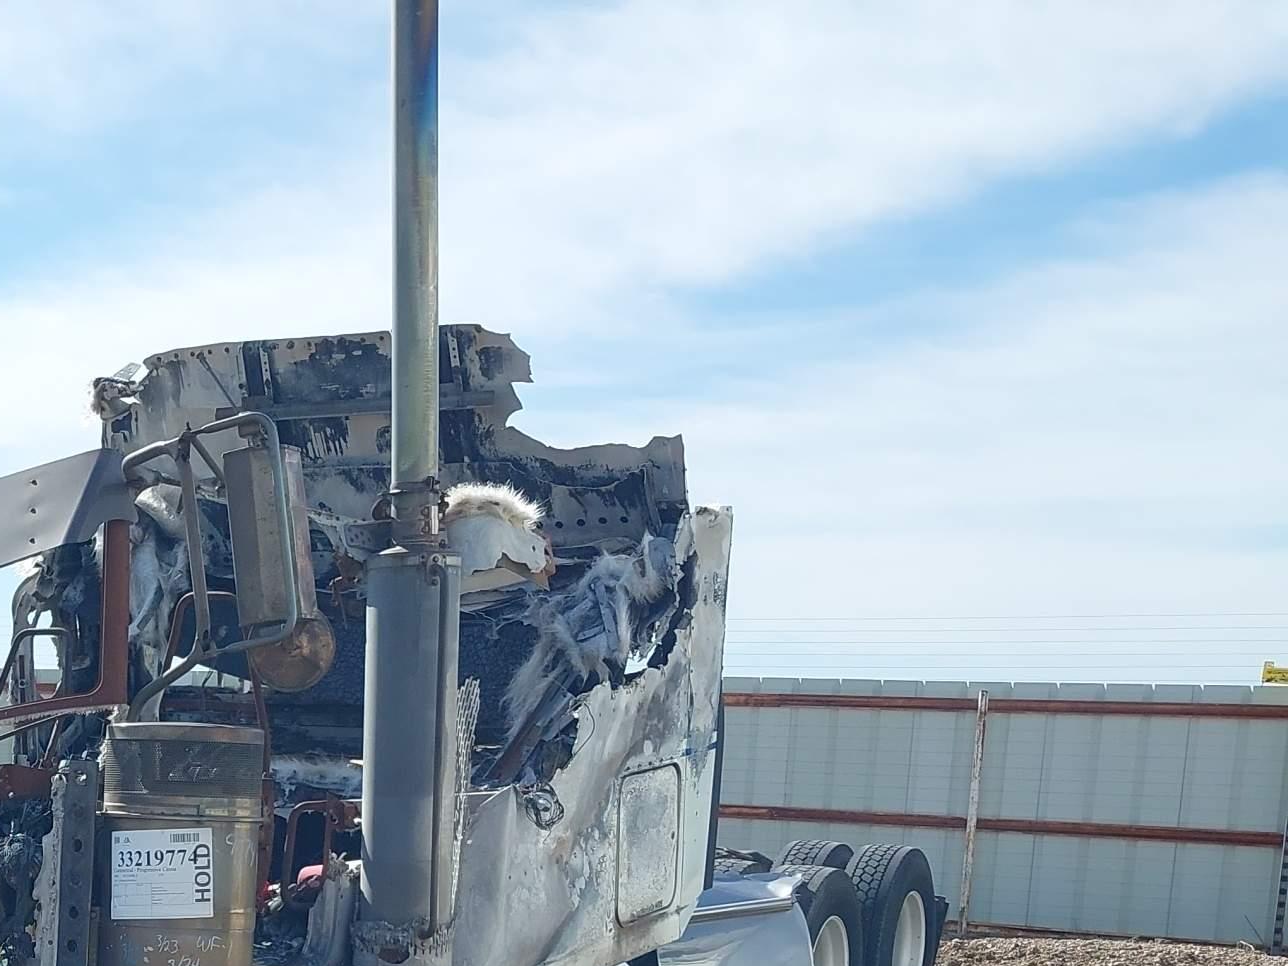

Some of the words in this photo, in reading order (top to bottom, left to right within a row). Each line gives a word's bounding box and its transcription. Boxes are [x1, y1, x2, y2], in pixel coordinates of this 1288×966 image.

[118, 849, 198, 867] 33219774
[194, 844, 211, 902] HOLD
[156, 934, 179, 954] 3/23
